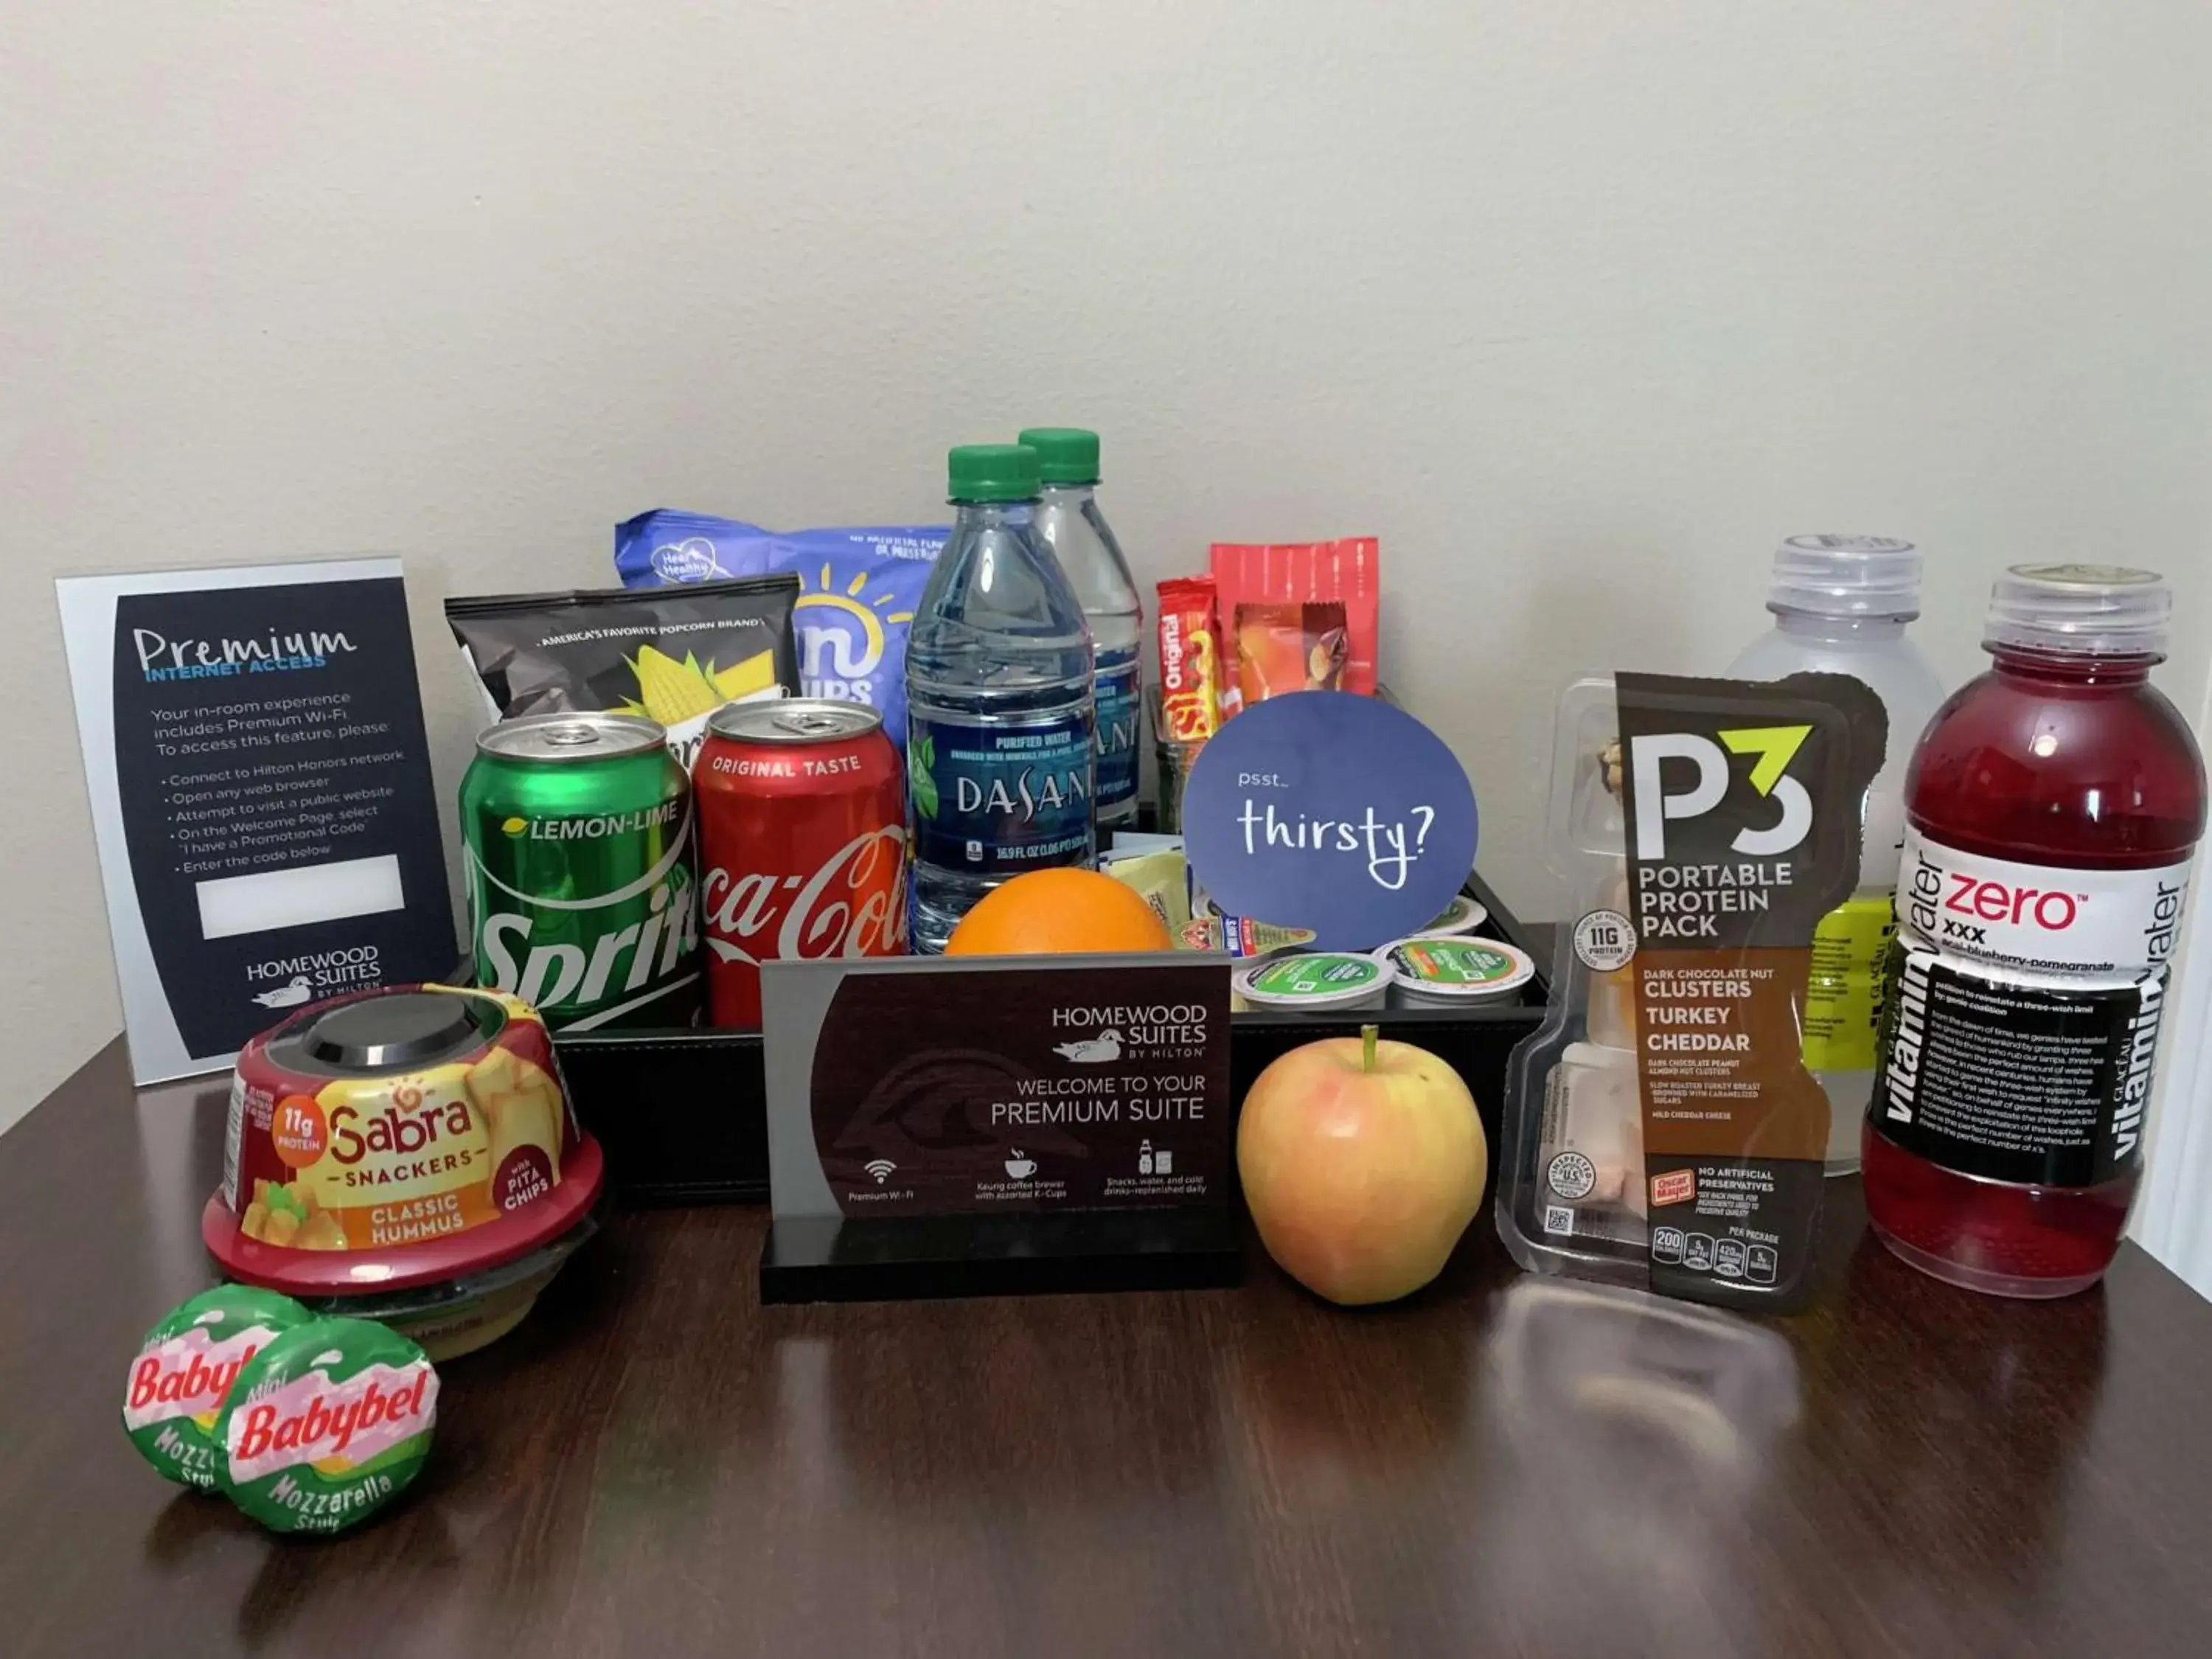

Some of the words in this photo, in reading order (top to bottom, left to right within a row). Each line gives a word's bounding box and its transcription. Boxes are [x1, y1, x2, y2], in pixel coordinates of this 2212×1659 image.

[543, 629, 602, 647] AMERICA'S
[603, 627, 656, 638] FAVORITE
[660, 622, 714, 635] POPCORN
[133, 627, 357, 671] Premium
[145, 661, 243, 682] INTERNET
[248, 655, 327, 672] ACCESS
[150, 708, 189, 721] Your
[194, 703, 260, 717] in-room
[263, 693, 352, 712] experience
[154, 722, 223, 738] includes
[228, 714, 302, 731] Premium
[156, 743, 176, 756] To
[181, 739, 237, 754] access
[241, 734, 271, 748] this
[996, 736, 1042, 749] PURIFIED
[1045, 731, 1071, 745] WATER
[170, 771, 231, 786] Connect
[235, 769, 249, 779] to
[253, 764, 294, 776] Hilton
[297, 757, 348, 772] Honors
[713, 757, 796, 777] ORIGINAL
[804, 755, 861, 776] TASTE
[173, 792, 212, 805] Open
[216, 788, 241, 800] any
[243, 783, 272, 795] web
[275, 778, 330, 792] browser
[1631, 725, 1814, 860] P3
[176, 807, 236, 822] Attempt
[240, 804, 254, 814] to
[257, 800, 285, 812] visit
[288, 800, 297, 808] a
[300, 793, 341, 808] public
[343, 787, 395, 801] website
[178, 829, 200, 840] On
[203, 826, 228, 837] the
[230, 818, 296, 833] Welcome
[339, 806, 378, 819] select
[530, 801, 678, 840] LEMON-LIME
[192, 841, 226, 853] have
[229, 840, 238, 849] a
[241, 827, 326, 846] Promotional
[1237, 799, 1436, 889] thirsty?
[183, 860, 221, 874] Enter
[225, 855, 249, 868] the
[253, 851, 288, 863] code
[997, 846, 1014, 859] 16.9
[1639, 862, 1792, 889] PORTABLE
[703, 824, 907, 959] ca-Col
[1641, 888, 1770, 913] PROTEIN
[1945, 872, 2076, 931] zero
[1590, 928, 1618, 946] 11G
[1643, 914, 1719, 937] PACK
[1943, 919, 1987, 945] xxx
[246, 945, 378, 981] HOMEWOOD
[1589, 947, 1623, 955] PROTEIN
[315, 961, 381, 986] SUITES
[1644, 969, 1674, 980] DARK
[1677, 969, 1748, 979] CHOCOLATE
[1750, 969, 1774, 978] NUT
[318, 989, 331, 998] BY
[337, 981, 380, 993] HILTON
[1644, 980, 1752, 998] CLUSTERS
[1052, 1005, 1207, 1027] HOMEWOOD
[1646, 1006, 1731, 1024] TURKEY
[1129, 1025, 1206, 1045] SUITES
[1647, 1034, 1751, 1051] CHEDDAR
[1129, 1049, 1144, 1059] BY
[1152, 1048, 1203, 1058] HILTON
[1669, 1059, 1709, 1067] CHOCOLATE
[1711, 1060, 1740, 1068] PEANUT
[1017, 1077, 1116, 1096] WELCOME
[1121, 1077, 1148, 1093] TO
[1152, 1075, 1206, 1091] YOUR
[285, 1107, 313, 1138] 11g
[992, 1099, 1119, 1125] PREMIUM
[1130, 1097, 1204, 1121] SUITE
[1671, 1111, 1703, 1119] CHEDDAR
[278, 1135, 320, 1150] PROTEIN
[328, 1100, 473, 1165] Sabra
[345, 1150, 473, 1187] SNACKERS
[512, 1158, 530, 1173] with
[1699, 1167, 1715, 1176] NO
[1717, 1169, 1774, 1180] ARTIFICIAL
[507, 1166, 539, 1192] PITA
[977, 1181, 1005, 1192] Keurig
[1006, 1180, 1032, 1190] coffee
[1034, 1180, 1065, 1189] brewer
[1167, 1175, 1183, 1184] and
[1185, 1175, 1204, 1184] cold
[1186, 1184, 1207, 1194] daily
[1699, 1178, 1775, 1192] PRESERVATIVES
[505, 1178, 548, 1211] CHIPS
[849, 1191, 888, 1202] Premium
[975, 1191, 995, 1200] with
[996, 1190, 1032, 1199] assorted
[372, 1194, 458, 1224] CLASSIC
[372, 1212, 463, 1244] HUMMUS
[1657, 1231, 1680, 1248] 200
[1729, 1226, 1745, 1236] PER
[1746, 1230, 1779, 1244] PACKAGE
[131, 1344, 256, 1409] Baby
[247, 1371, 288, 1402] Mini
[236, 1370, 428, 1461] Babybel
[268, 1474, 392, 1515] Mozzarella
